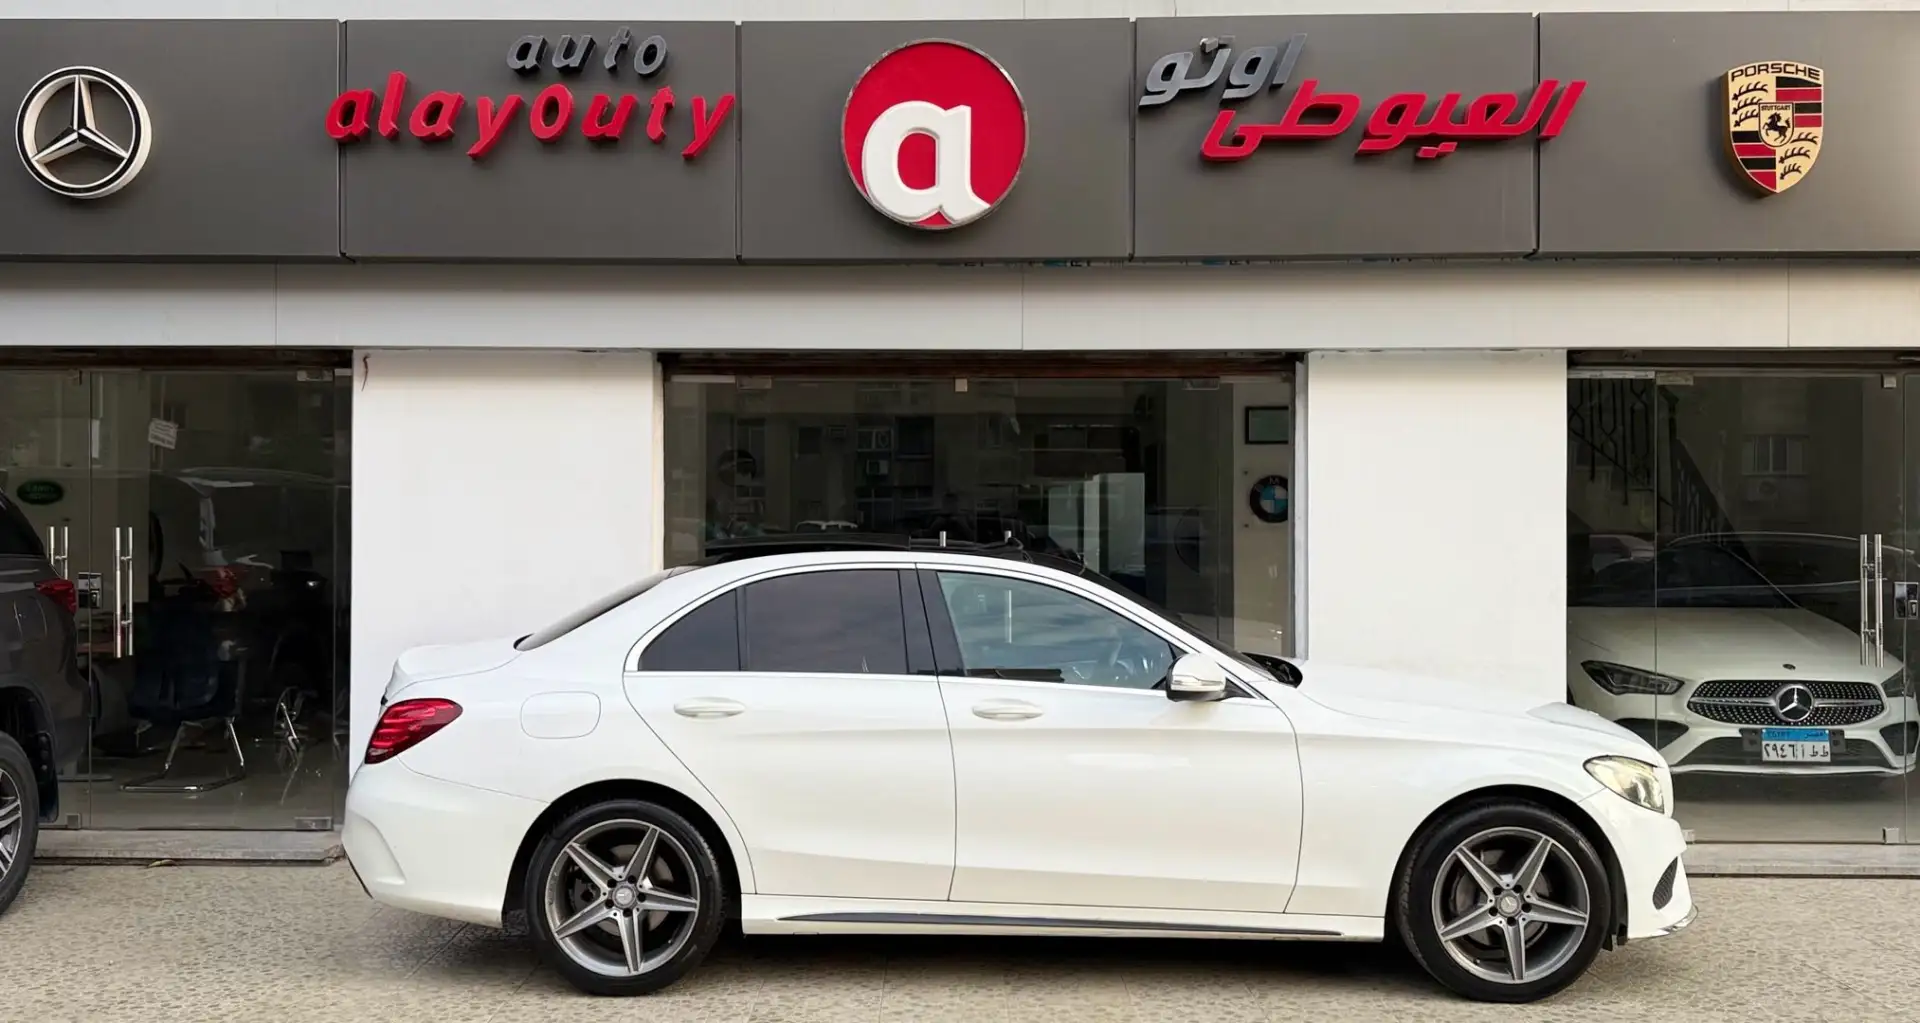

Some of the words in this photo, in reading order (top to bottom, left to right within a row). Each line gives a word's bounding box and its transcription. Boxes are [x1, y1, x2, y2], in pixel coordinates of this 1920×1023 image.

[507, 26, 668, 75] auto
[1138, 33, 1308, 107] اوتو
[1731, 63, 1820, 82] PORSCHE
[325, 71, 736, 160] alayouty
[862, 100, 991, 225] a
